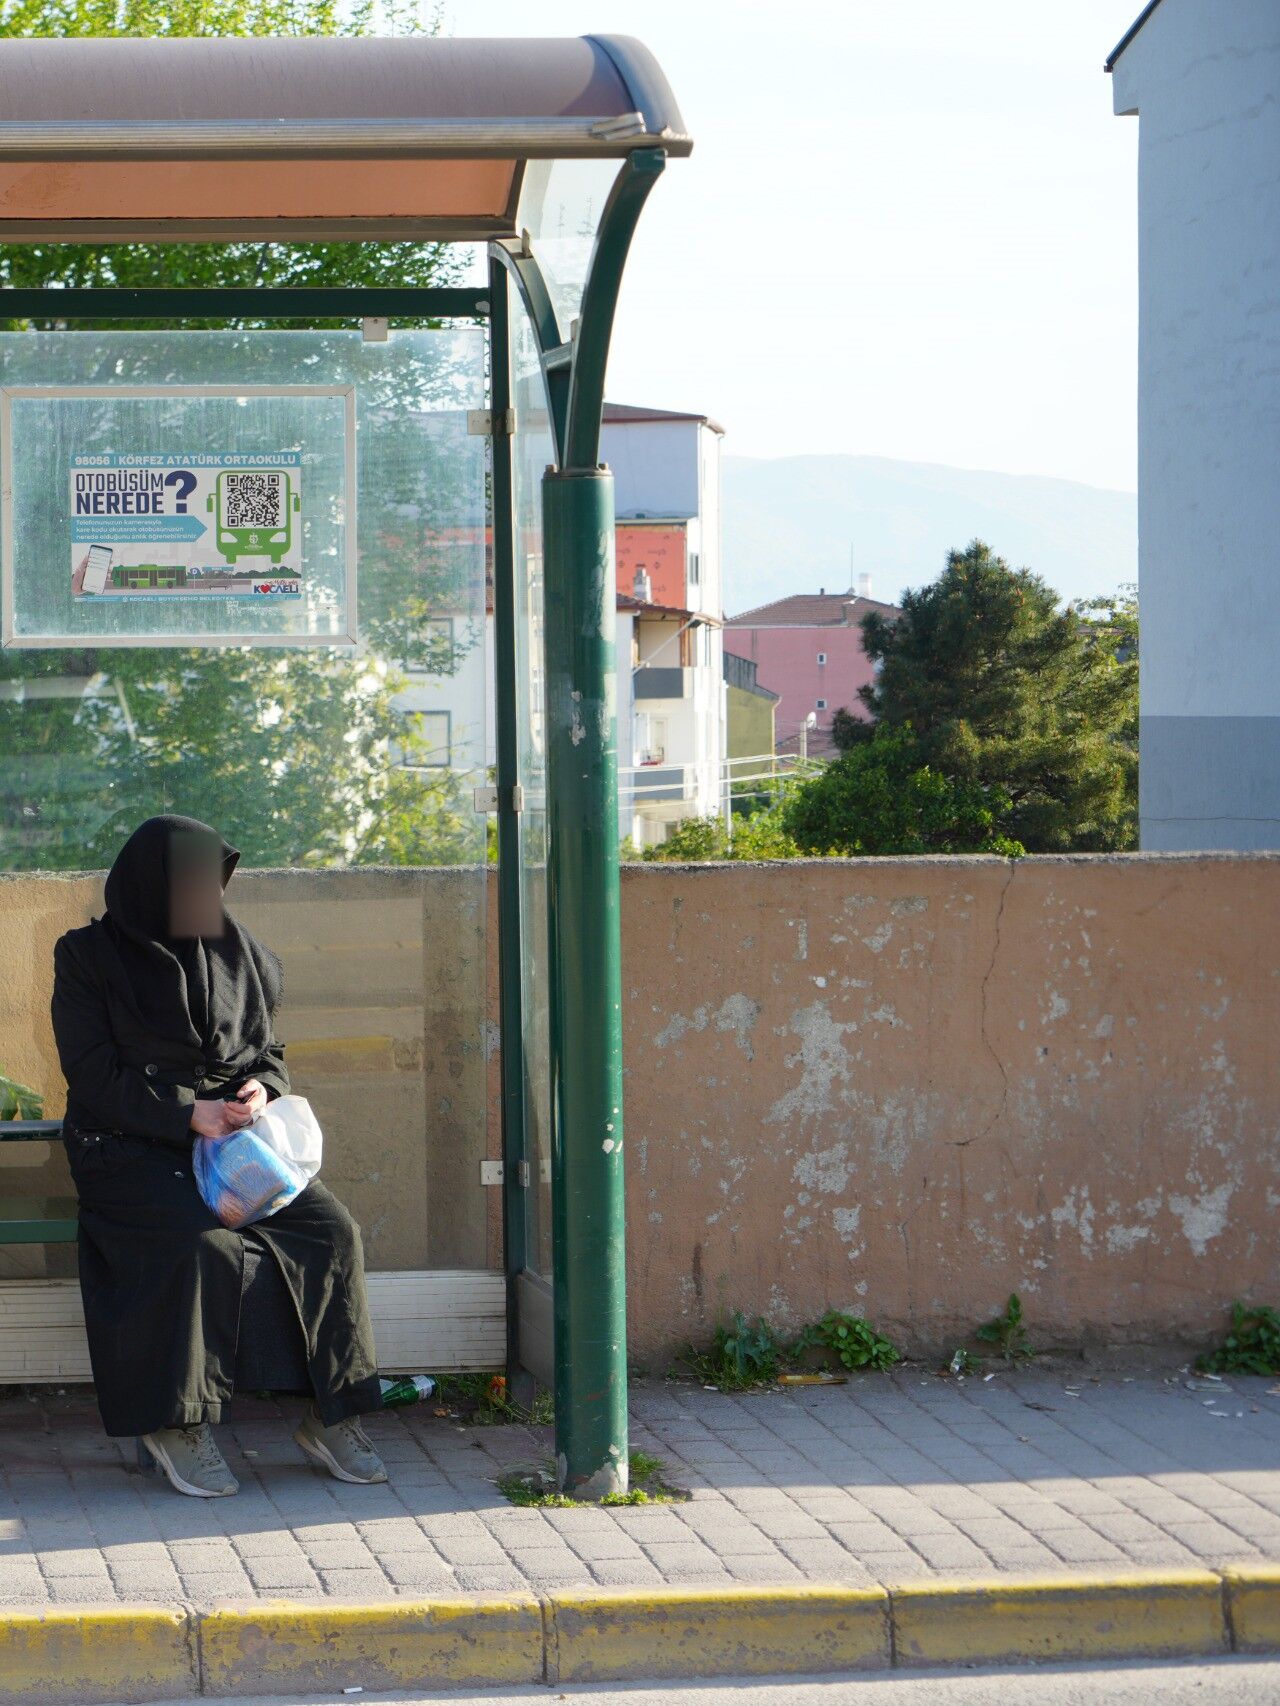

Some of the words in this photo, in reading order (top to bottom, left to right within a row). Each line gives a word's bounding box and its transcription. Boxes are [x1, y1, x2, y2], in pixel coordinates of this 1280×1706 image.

[118, 454, 164, 465] KÖRFEZ
[166, 454, 222, 465] ATATÜRK
[224, 454, 296, 465] ORTAOKULU
[76, 470, 164, 492] OTOBÜSÜM
[76, 492, 164, 514] NEREDE
